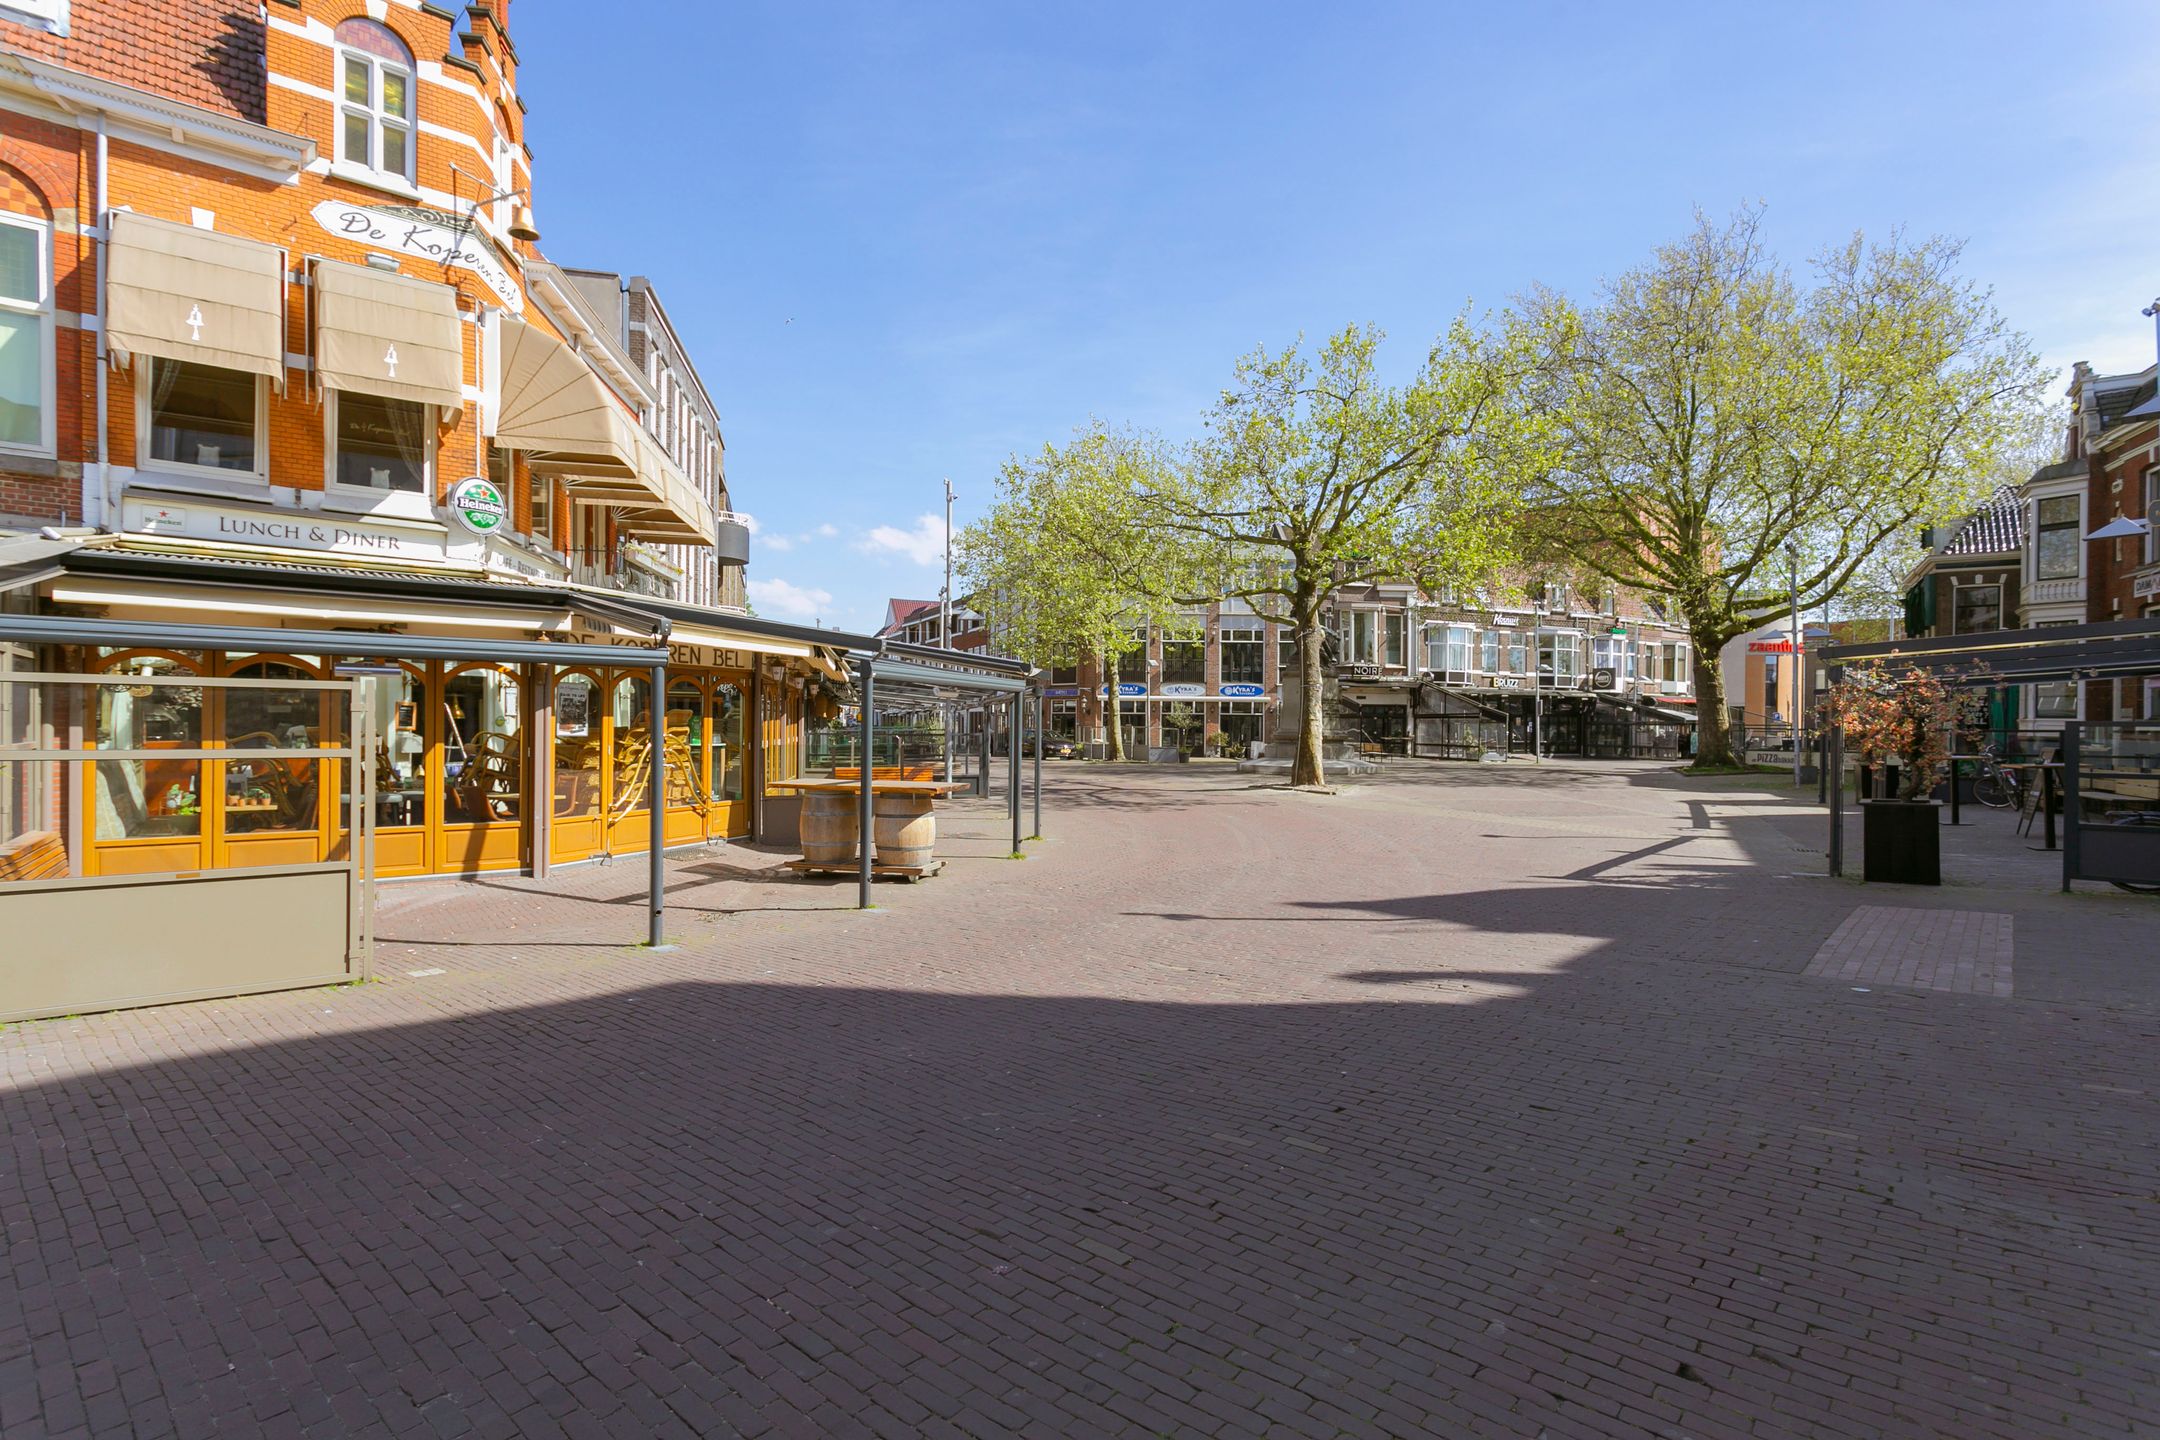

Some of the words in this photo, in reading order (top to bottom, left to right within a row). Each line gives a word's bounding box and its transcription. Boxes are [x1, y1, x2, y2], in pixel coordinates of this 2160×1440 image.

[339, 211, 386, 240] De
[219, 516, 299, 539] LUNCH
[309, 526, 327, 542] &
[335, 528, 400, 550] DINER
[712, 648, 745, 669] BEL
[1354, 666, 1383, 675] NOIRE
